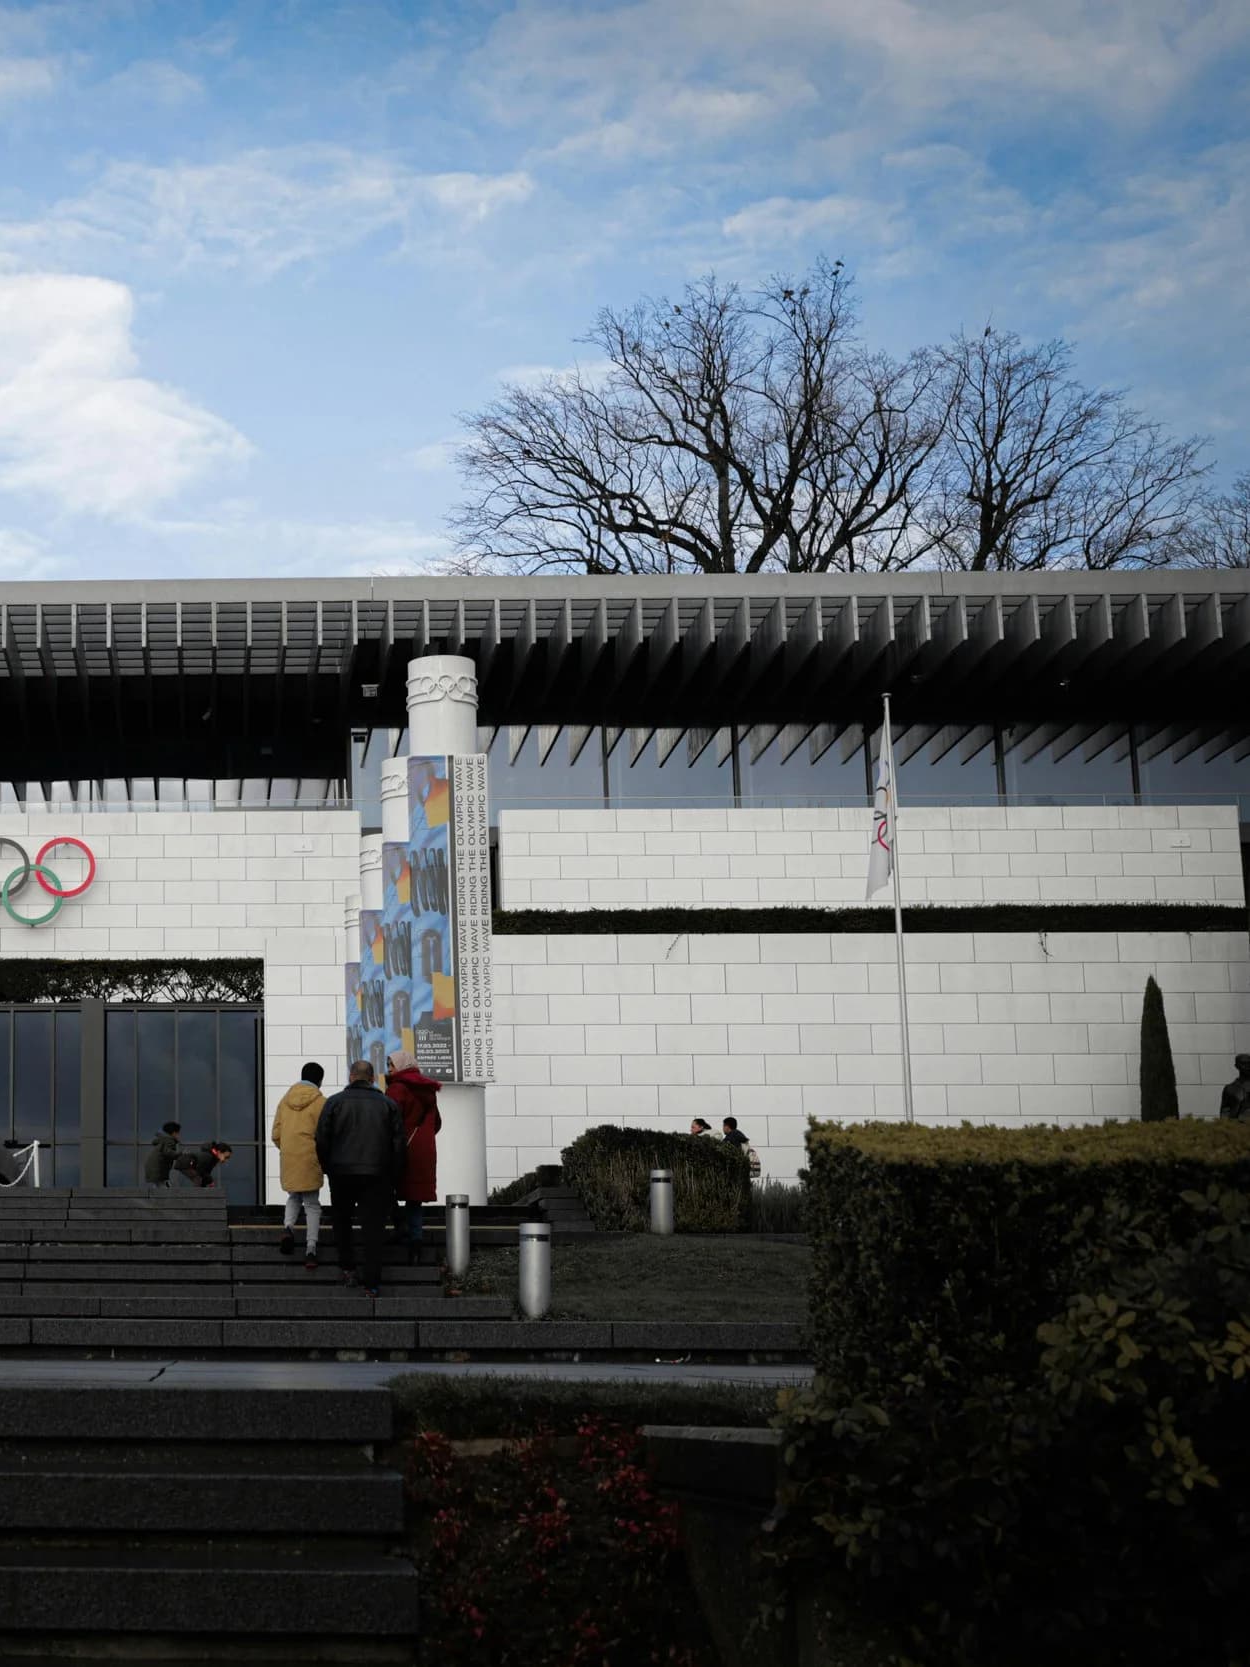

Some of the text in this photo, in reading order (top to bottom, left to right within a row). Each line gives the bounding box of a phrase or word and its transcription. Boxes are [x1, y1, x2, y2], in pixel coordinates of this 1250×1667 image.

[466, 757, 474, 791] WAVE
[456, 794, 464, 846] OLYMPIC
[467, 794, 476, 846] OLYMPIC
[478, 794, 487, 846] OLYMPIC
[458, 876, 466, 916] RIDING
[469, 876, 477, 916] RIDING
[480, 876, 489, 916] RIDING
[482, 920, 490, 953] WAVE
[460, 957, 469, 1008] OLYMPIC
[472, 957, 480, 1008] OLYMPIC
[483, 957, 492, 1008] OLYMPIC
[463, 1038, 471, 1078] RIDING
[474, 1038, 483, 1078] RIDING
[486, 1038, 494, 1078] RIDING
